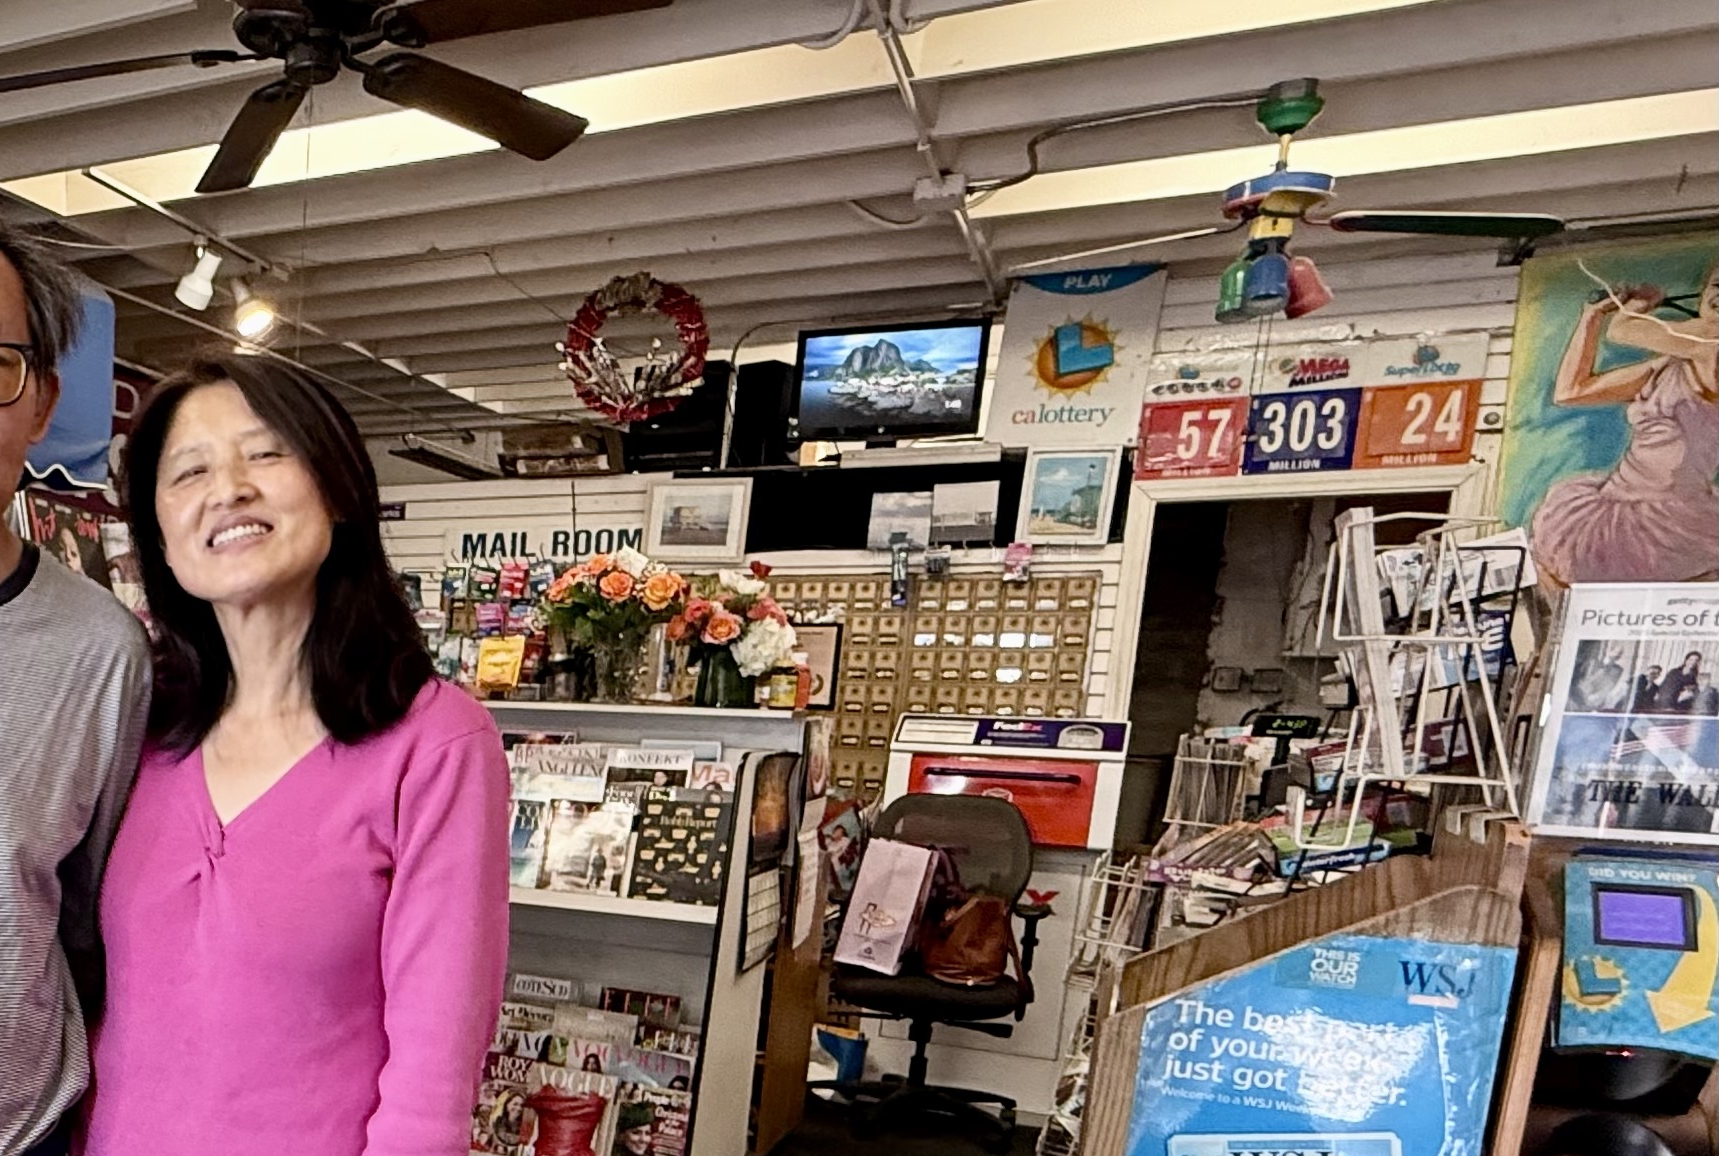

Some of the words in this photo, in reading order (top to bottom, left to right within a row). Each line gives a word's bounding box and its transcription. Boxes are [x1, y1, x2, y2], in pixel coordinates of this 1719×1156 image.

[1062, 273, 1112, 290] PLAY
[1297, 356, 1350, 378] MEGA
[1010, 404, 1115, 428] calottery
[1259, 398, 1347, 454] 303
[1401, 389, 1464, 446] 24
[1178, 408, 1232, 460] 57
[1266, 459, 1321, 472] MILLION
[461, 531, 539, 559] MAIL
[551, 528, 644, 558] ROOM
[1580, 609, 1677, 628] Pictures
[1682, 609, 1710, 627] of
[616, 750, 683, 766] KONFEKT
[1587, 779, 1643, 805] THE
[1587, 867, 1616, 879] DID
[1620, 868, 1652, 881] YOU
[1655, 869, 1697, 883] WIN?
[1309, 959, 1360, 975] OUR
[1314, 947, 1345, 960] THIS
[1347, 951, 1361, 963] IS
[1399, 959, 1479, 998] WSJ
[1175, 999, 1235, 1029] The
[1167, 1028, 1203, 1051] of
[1208, 1034, 1279, 1066] your
[539, 1065, 615, 1100] VOGUE
[1161, 1054, 1231, 1084] just
[1232, 1065, 1289, 1094] got
[1160, 1086, 1216, 1103] Welcome
[1217, 1092, 1231, 1104] to
[1243, 1095, 1272, 1110] WSJ
